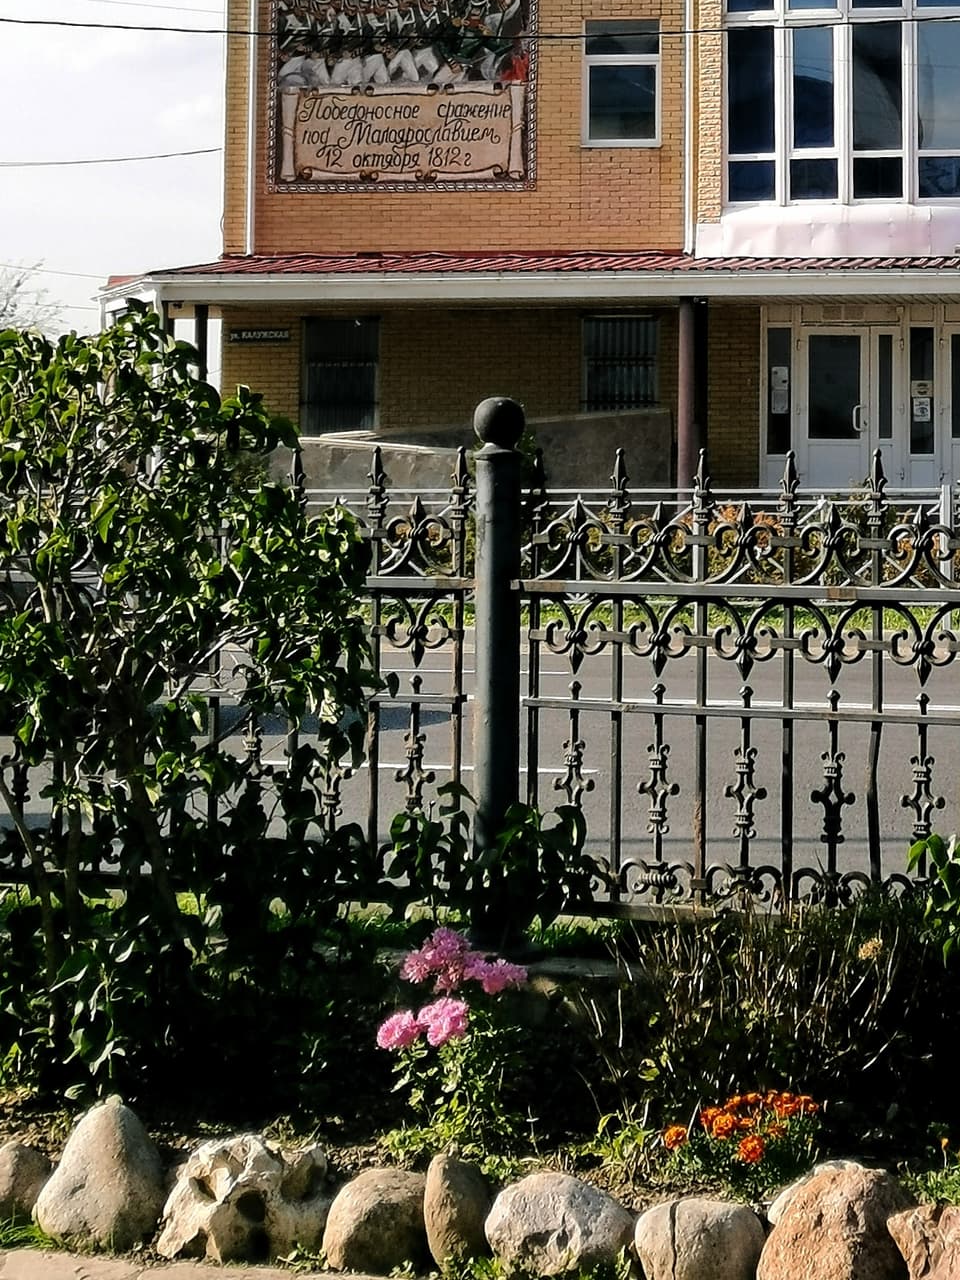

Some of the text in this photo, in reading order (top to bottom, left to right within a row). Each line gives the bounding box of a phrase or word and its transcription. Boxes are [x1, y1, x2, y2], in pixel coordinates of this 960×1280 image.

[298, 96, 512, 127] Победоносное сражение
[324, 148, 343, 168] 12
[352, 145, 420, 173] октября
[428, 146, 462, 167] 1812
